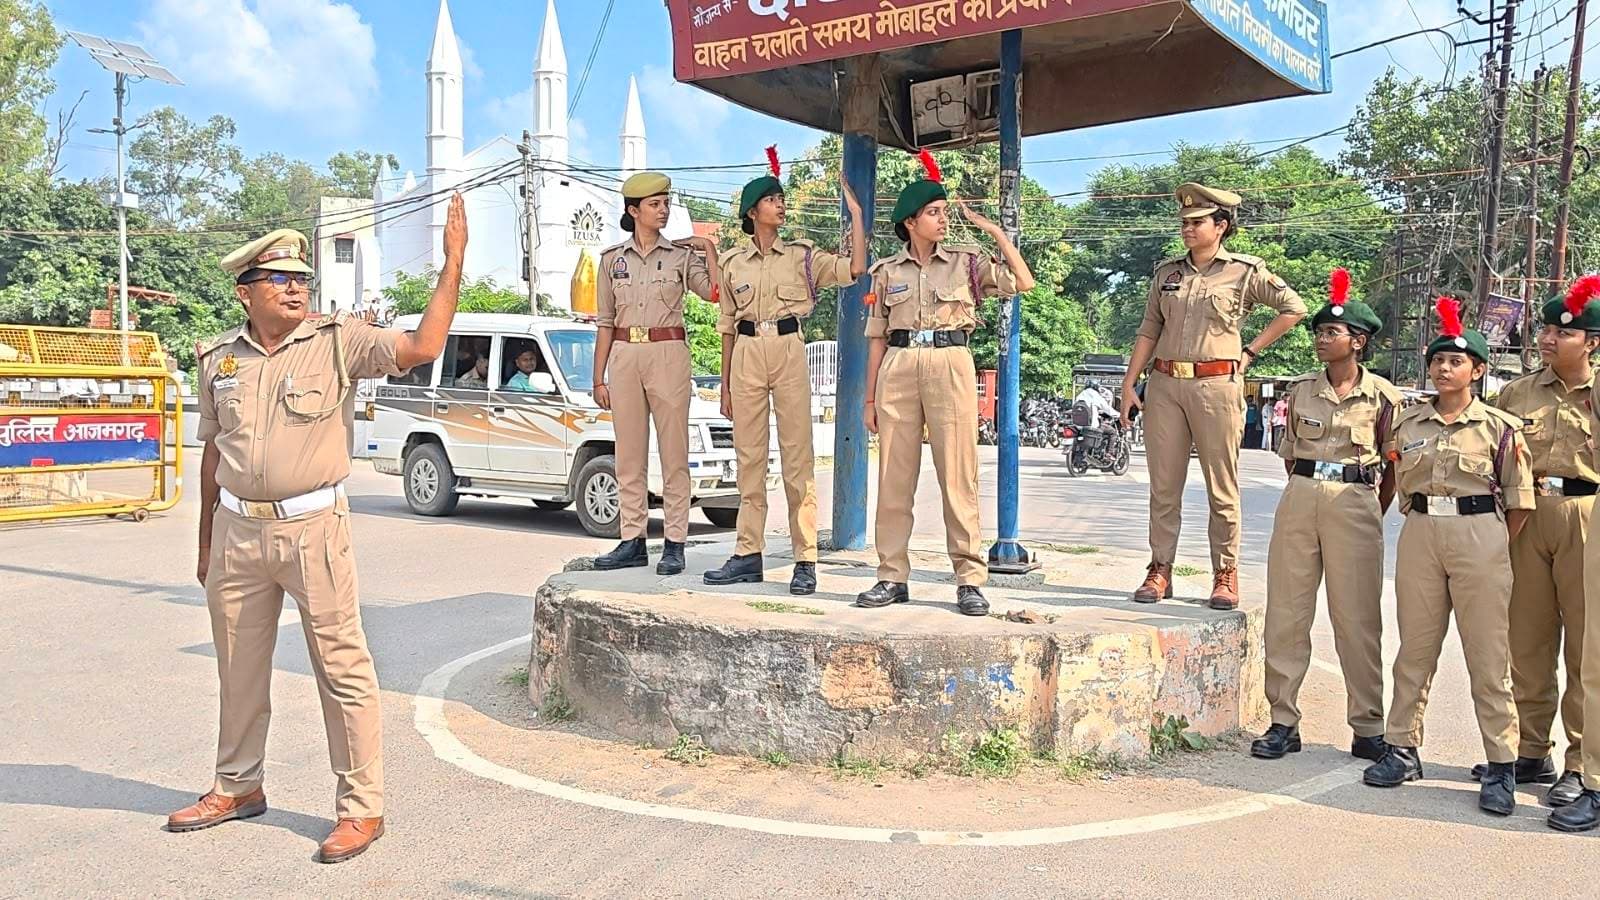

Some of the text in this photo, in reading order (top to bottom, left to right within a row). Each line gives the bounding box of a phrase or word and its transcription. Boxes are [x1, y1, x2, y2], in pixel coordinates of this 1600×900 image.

[694, 38, 749, 70] वाहन
[751, 18, 809, 60] चलाते
[812, 13, 871, 49] समय
[875, 1, 956, 36] मोबाइल
[573, 231, 601, 241] IZUSA
[381, 389, 408, 398] GOLD
[63, 422, 147, 443] आजमगढ़
